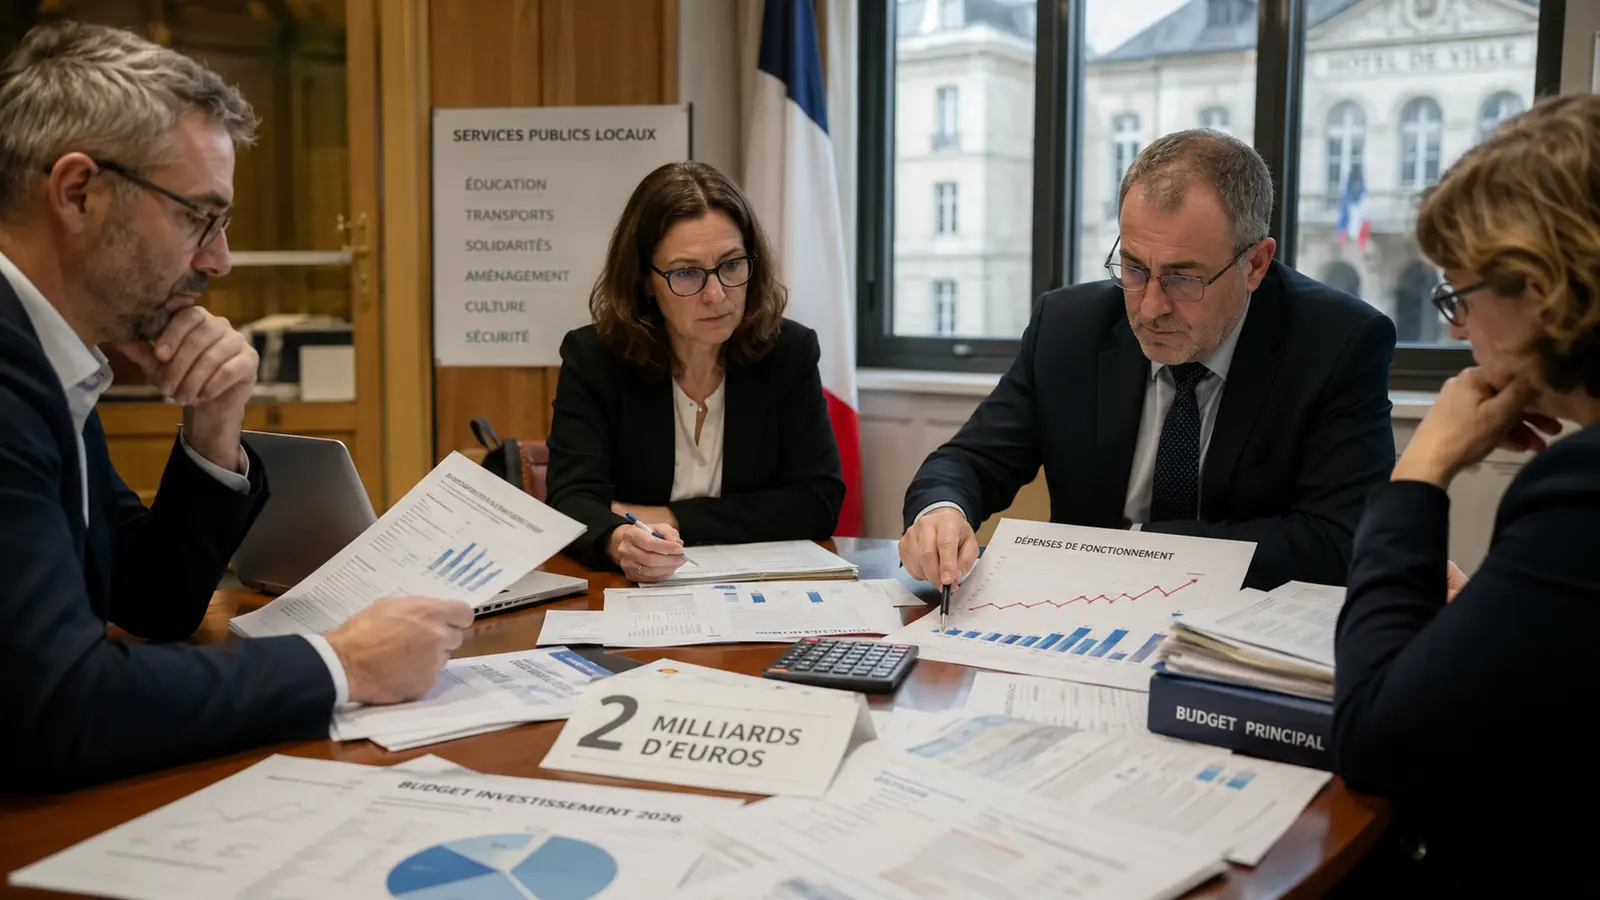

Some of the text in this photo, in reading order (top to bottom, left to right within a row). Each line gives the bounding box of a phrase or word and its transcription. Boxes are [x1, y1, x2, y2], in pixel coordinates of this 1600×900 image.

[453, 128, 657, 142] SERVICES PUBLICS LOCAUX
[465, 176, 547, 191] ÉDUCATION
[465, 209, 555, 221] TRANSPORTS
[465, 238, 552, 252] SOLIDARITÉS
[465, 268, 570, 282] AMÉNAGEMENT
[465, 300, 526, 313] CULTURE
[465, 329, 529, 343] SÉCURITÉ
[1014, 535, 1175, 561] DÉPENSES DE FONCTIONNEMENT
[576, 694, 639, 751] 2
[1175, 705, 1325, 751] BUDGET PRINCIPAL
[651, 715, 803, 746] MILLIARDS
[640, 738, 766, 768] D'EUROS
[398, 781, 474, 796] BUDGET
[475, 790, 634, 817] INVESTISSEMENT
[636, 810, 683, 823] 2026
